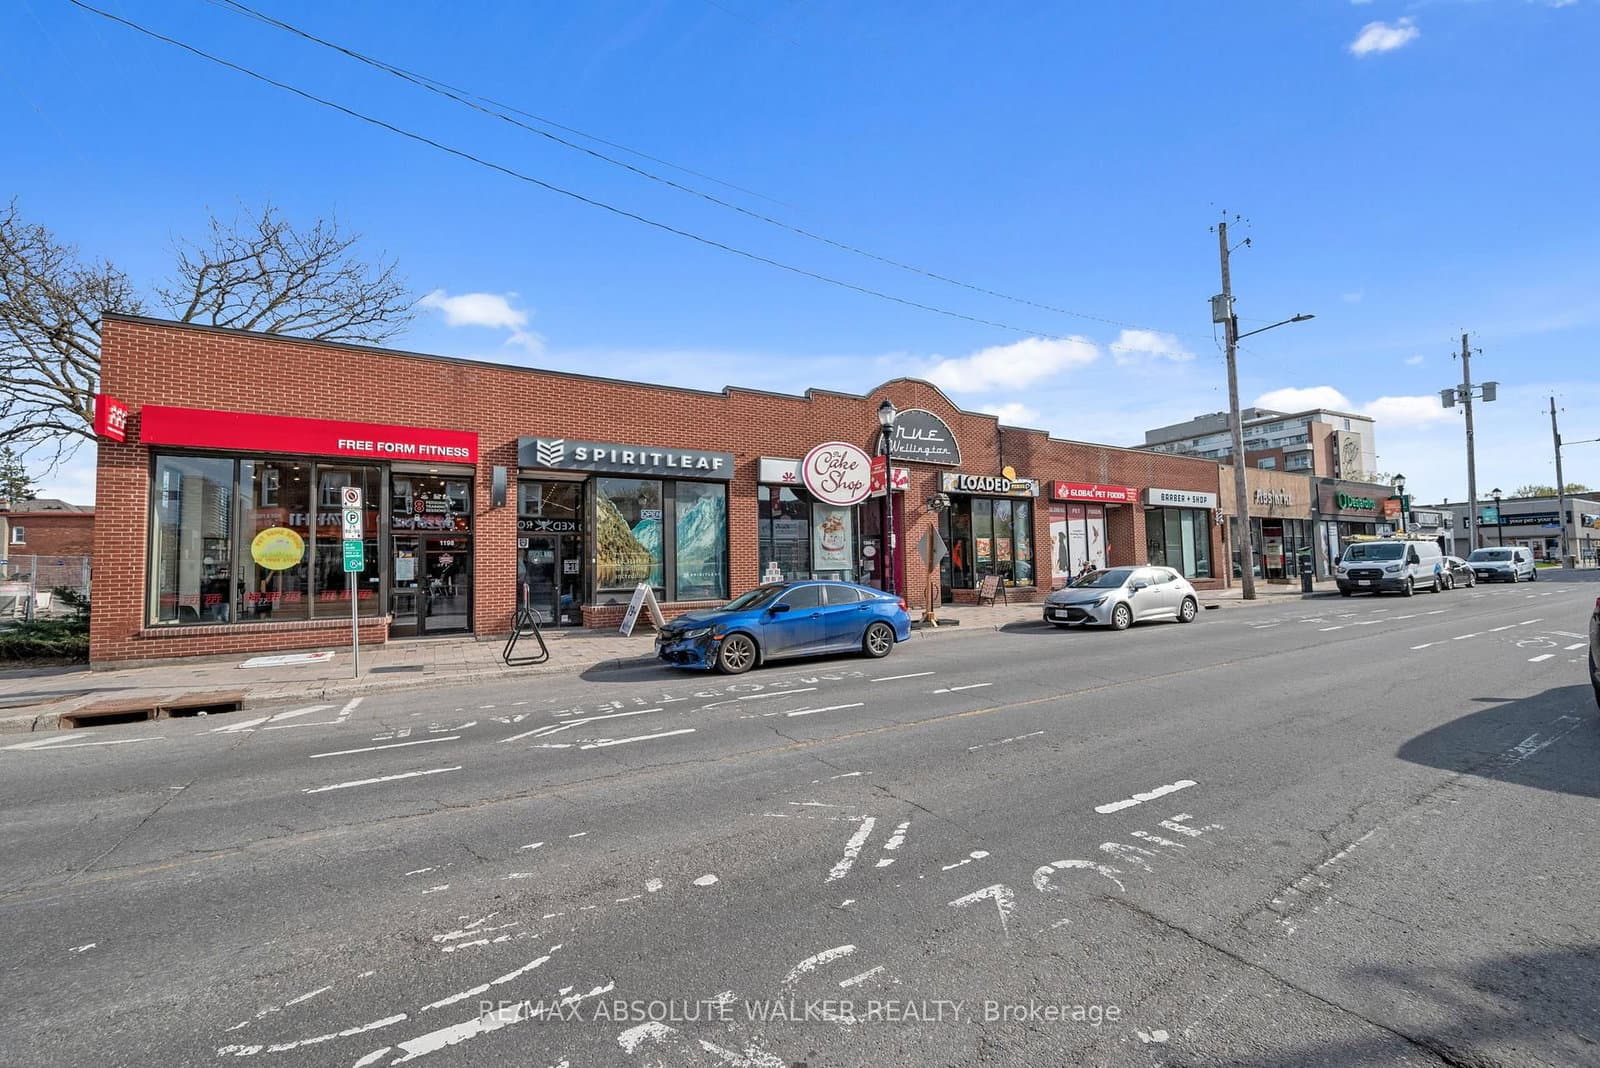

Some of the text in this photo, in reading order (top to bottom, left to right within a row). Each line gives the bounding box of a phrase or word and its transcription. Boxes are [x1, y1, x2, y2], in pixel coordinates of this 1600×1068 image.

[338, 439, 470, 457] FREE FORM FITNESS
[889, 438, 951, 457] Wellington
[574, 446, 724, 471] SPIRITLEAF
[814, 451, 859, 476] Cake
[821, 470, 865, 498] Shop
[959, 476, 1011, 493] LOADED
[1070, 489, 1093, 497] GLOBAL
[1095, 490, 1106, 498] PET
[1107, 491, 1126, 499] FOODS
[1160, 493, 1185, 502] BARBER
[1192, 495, 1208, 504] SHOP
